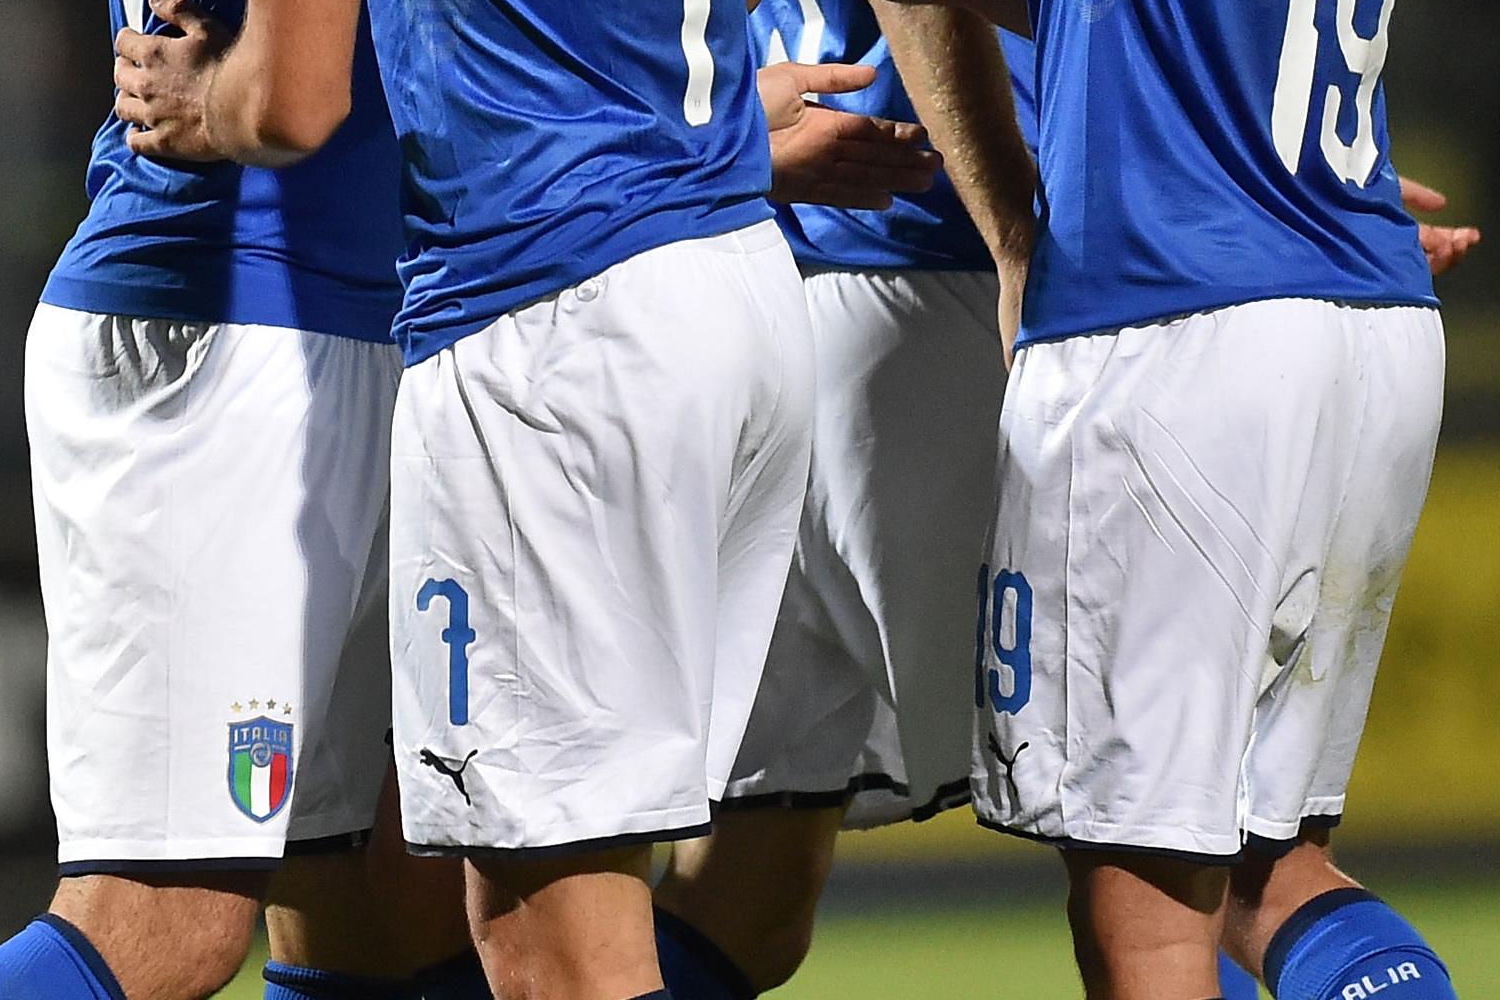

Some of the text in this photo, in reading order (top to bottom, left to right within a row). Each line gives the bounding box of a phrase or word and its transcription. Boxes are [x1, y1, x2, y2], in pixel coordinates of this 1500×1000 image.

[416, 578, 476, 726] 7
[233, 726, 288, 744] ITALIA
[1331, 961, 1422, 1000] ALIA
